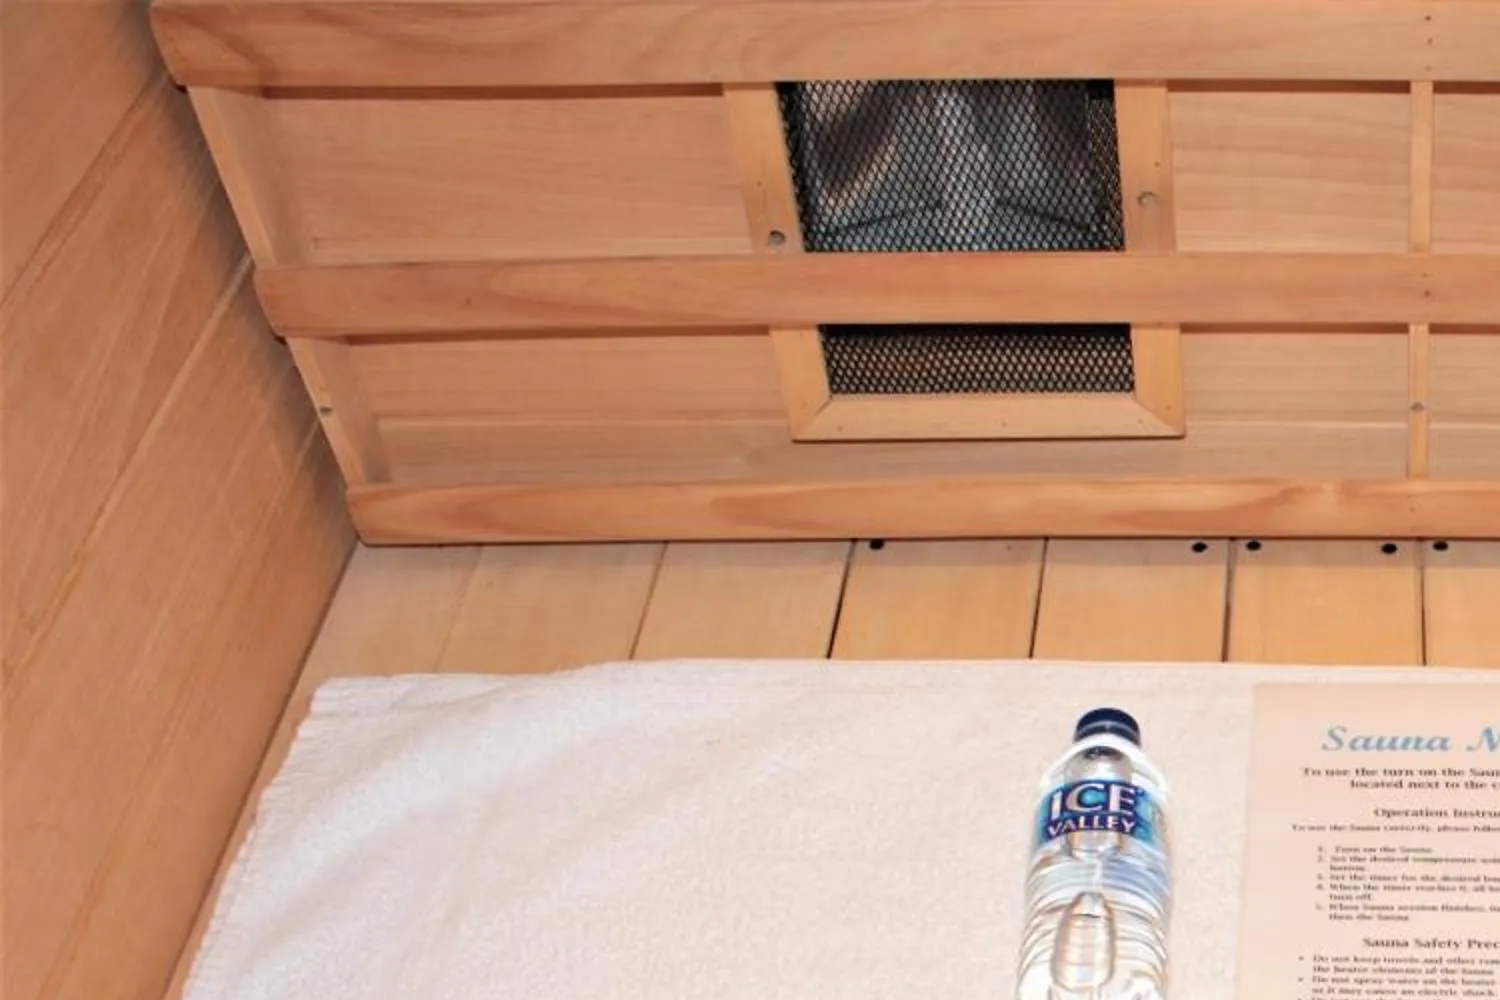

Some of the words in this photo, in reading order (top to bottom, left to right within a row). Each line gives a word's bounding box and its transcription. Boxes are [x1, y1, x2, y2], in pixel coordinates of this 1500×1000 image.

[1322, 725, 1452, 752] Sauna
[1300, 767, 1321, 776] To
[1325, 769, 1350, 777] use
[1355, 768, 1378, 776] the
[1382, 769, 1414, 777] turn
[1417, 769, 1437, 777] on
[1441, 768, 1465, 777] the
[1350, 780, 1404, 789] located
[1407, 781, 1440, 789] next
[1444, 781, 1460, 789] to
[1464, 780, 1488, 790] the
[1050, 782, 1137, 820] ICE
[1373, 808, 1449, 818] Operation
[1047, 815, 1136, 837] VALLEY
[1362, 938, 1409, 948] Sauna
[1414, 938, 1462, 949] Safety
